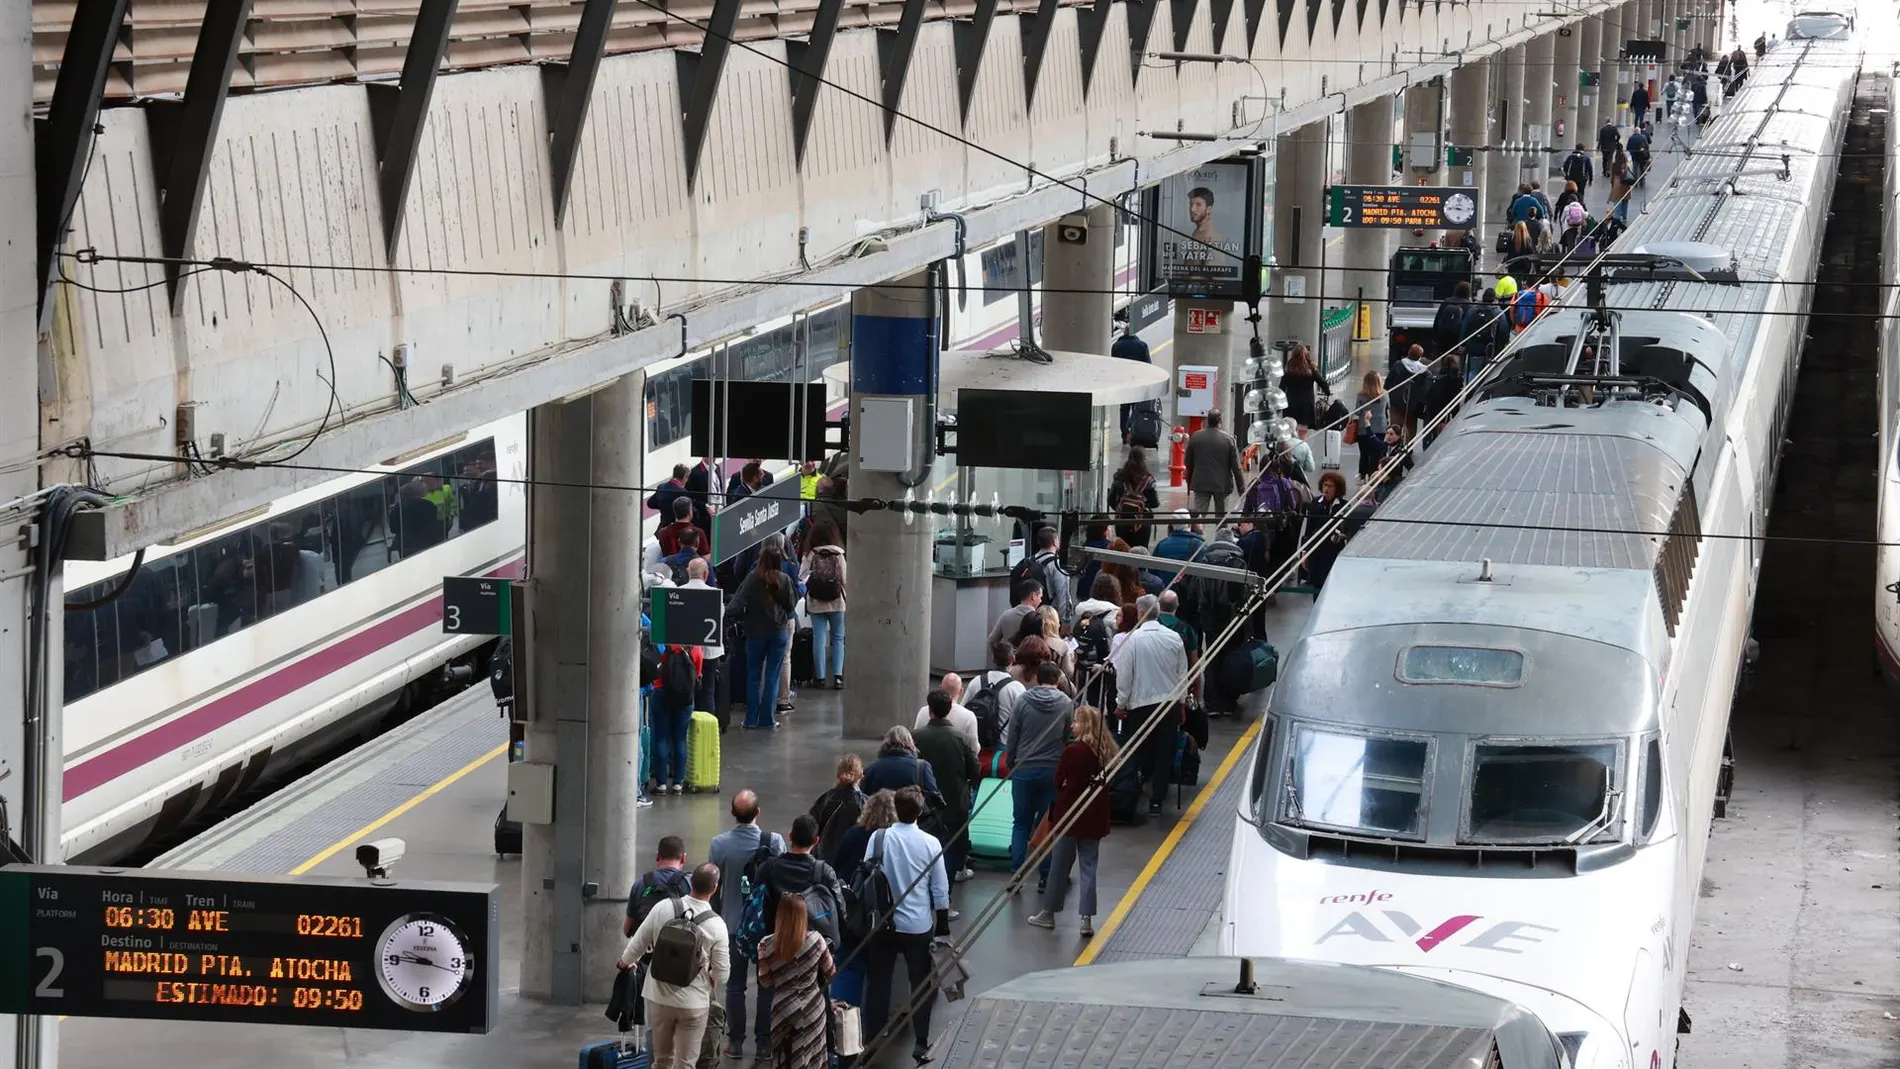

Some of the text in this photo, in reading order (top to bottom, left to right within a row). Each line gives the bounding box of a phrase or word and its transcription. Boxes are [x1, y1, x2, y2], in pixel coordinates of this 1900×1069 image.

[1466, 156, 1472, 166] 2
[1342, 207, 1352, 222] 2
[1181, 252, 1214, 260] YATRA
[740, 500, 779, 535] Sevilla Santa Justa
[447, 605, 460, 630] 3
[704, 618, 717, 643] 2
[38, 887, 58, 899] Vía
[102, 890, 134, 904] Hora
[1320, 889, 1393, 906] renfe
[150, 896, 169, 905] TIME
[186, 894, 215, 907] Tren
[233, 900, 255, 909] TRAIN
[36, 908, 76, 918] PLATFORM
[105, 906, 229, 932] 06:30 AVE
[297, 914, 364, 938] 02261
[418, 926, 434, 937] 12
[1313, 910, 1560, 953] AVE
[101, 934, 152, 948] Destino
[169, 941, 218, 951] DESTINATION
[105, 950, 352, 981] MADRID PTA. ATOCHA
[451, 958, 460, 968] 3
[35, 947, 64, 998] 2
[156, 982, 362, 1011] ESTIMADO: 09:50
[419, 987, 430, 997] 6
